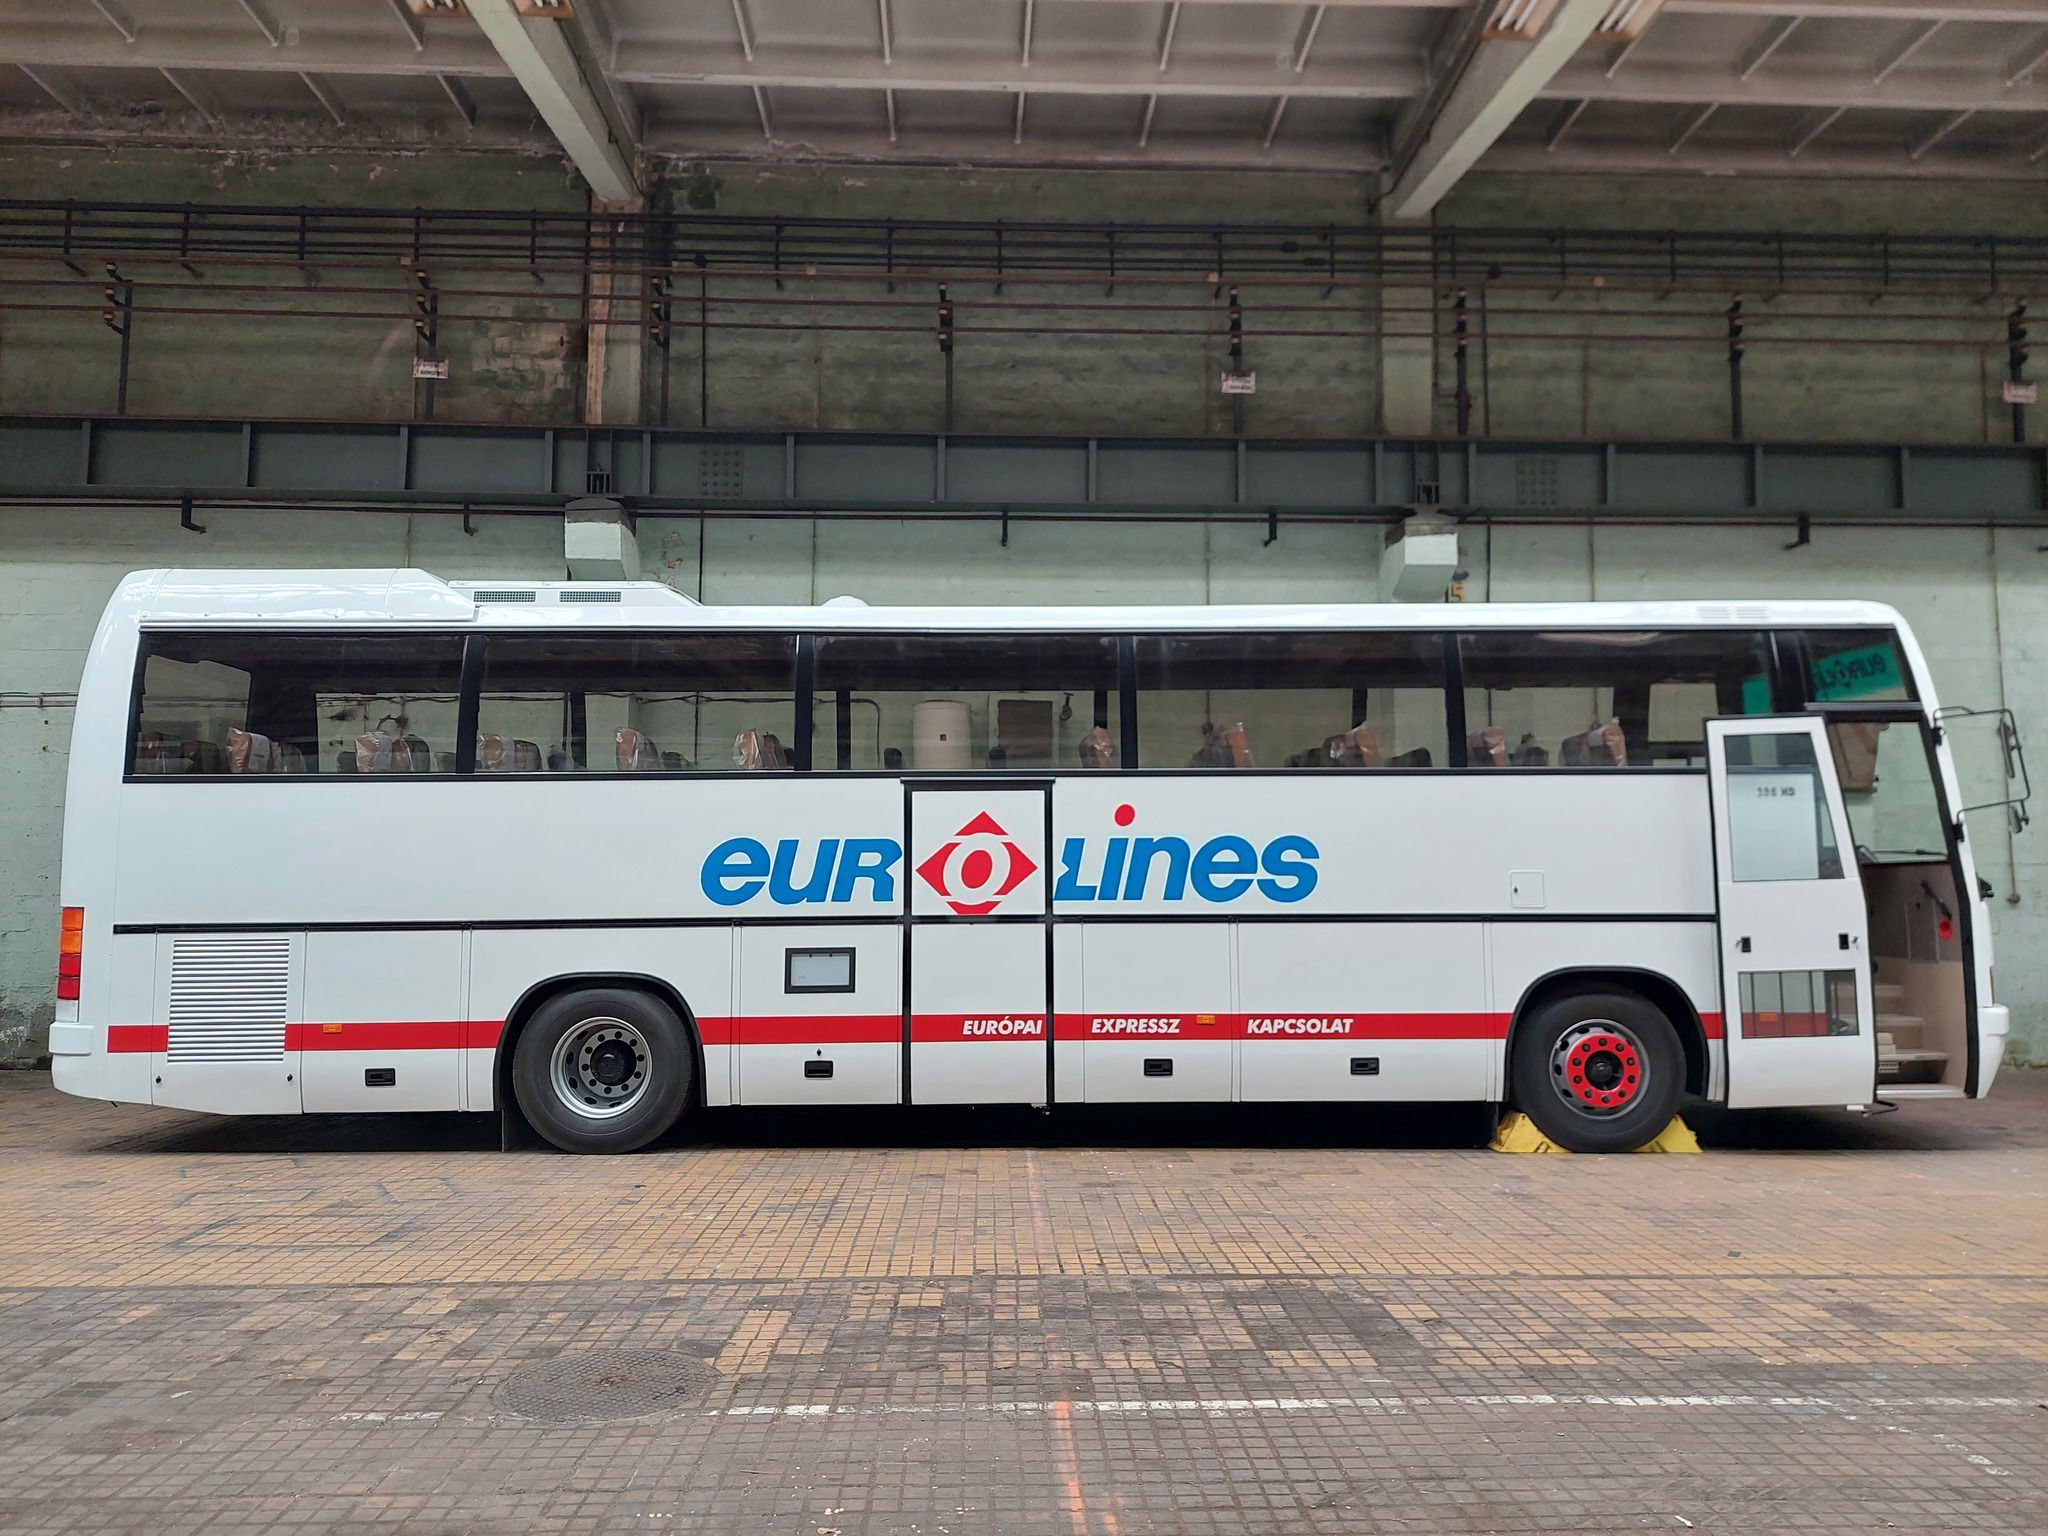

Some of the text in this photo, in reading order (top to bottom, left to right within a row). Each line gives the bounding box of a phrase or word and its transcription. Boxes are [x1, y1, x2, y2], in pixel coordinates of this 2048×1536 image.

[963, 1016, 1354, 1035] EURÓPAI EXPRESSZ KAPCSOLAT
